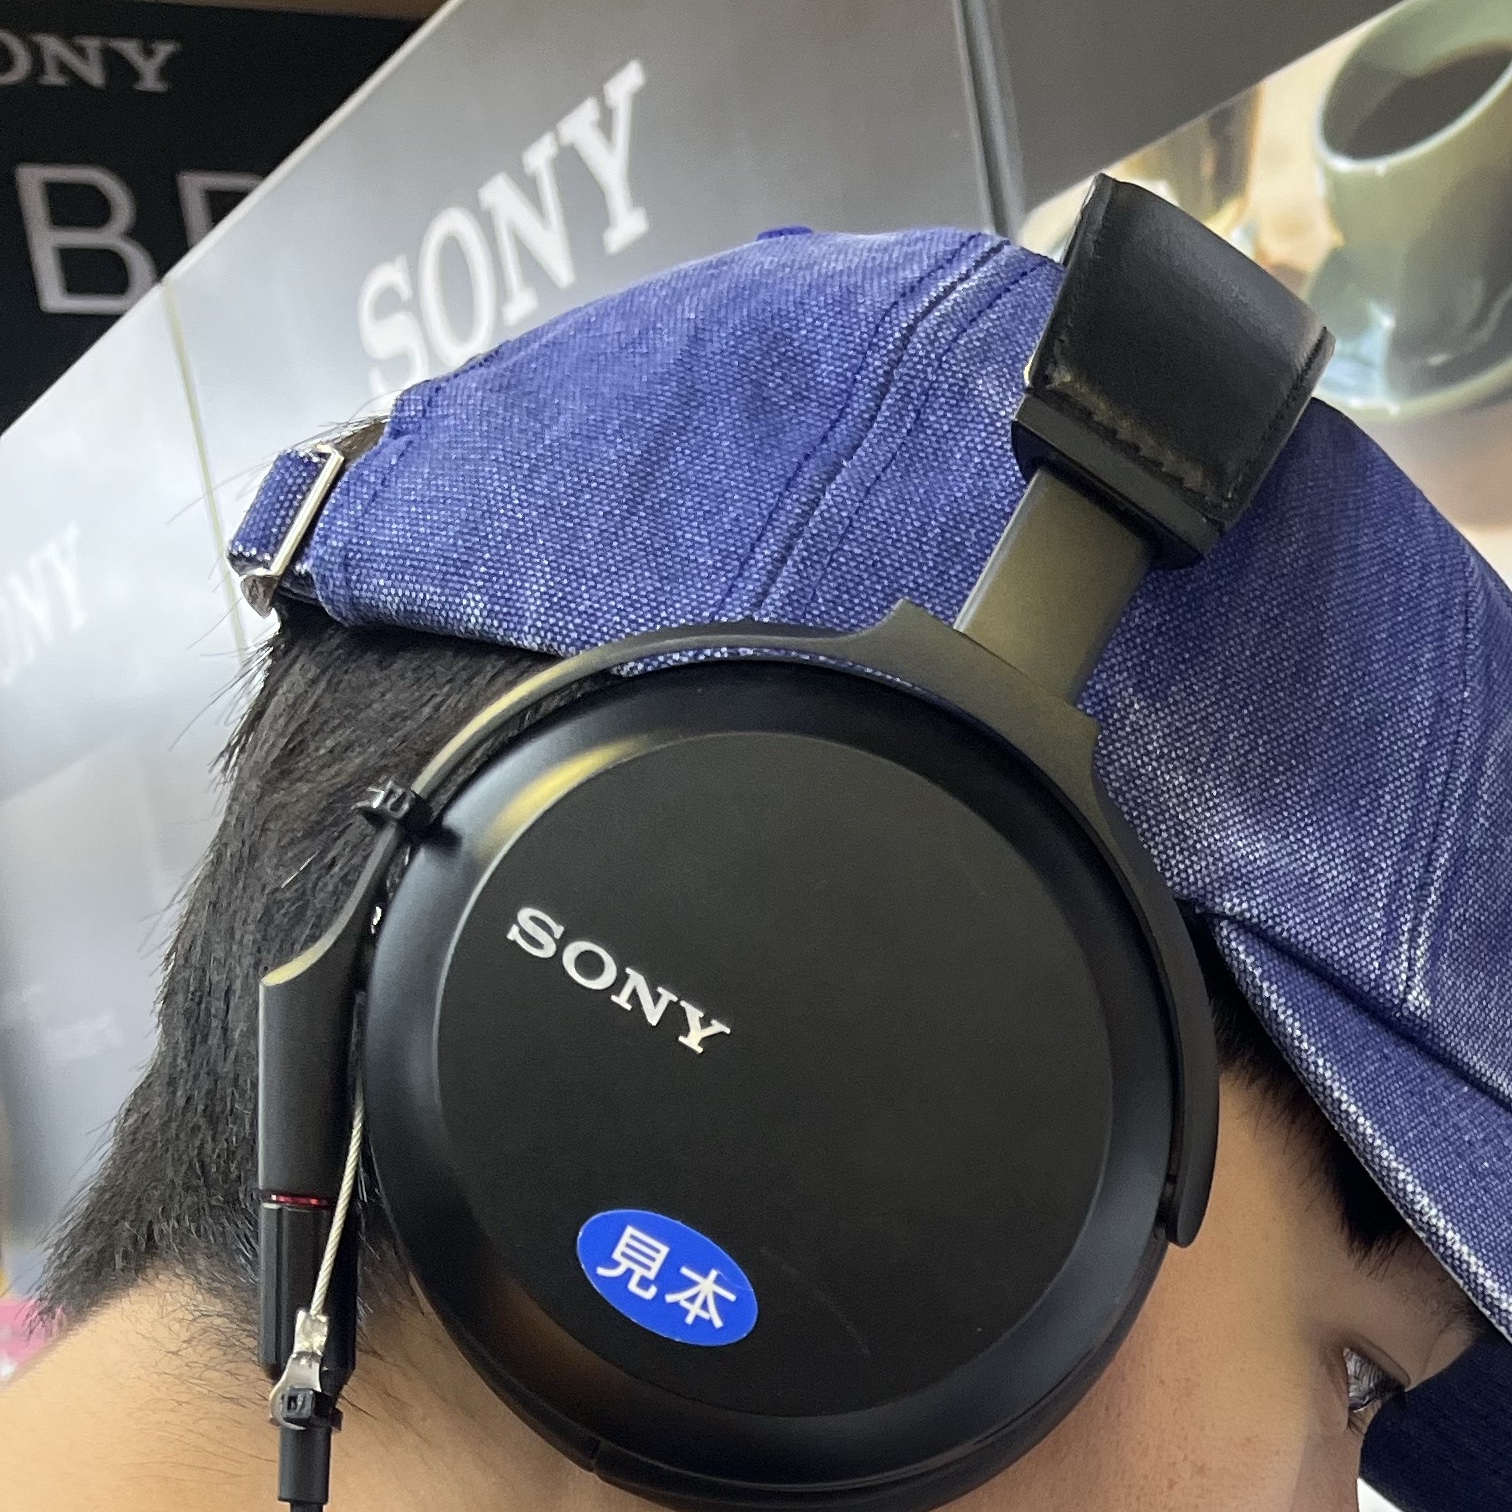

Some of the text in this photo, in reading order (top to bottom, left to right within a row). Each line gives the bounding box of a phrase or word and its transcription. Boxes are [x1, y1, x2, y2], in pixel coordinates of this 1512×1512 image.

[358, 60, 648, 398] SONY
[506, 906, 731, 1054] SONY
[597, 1226, 737, 1329] 見本
